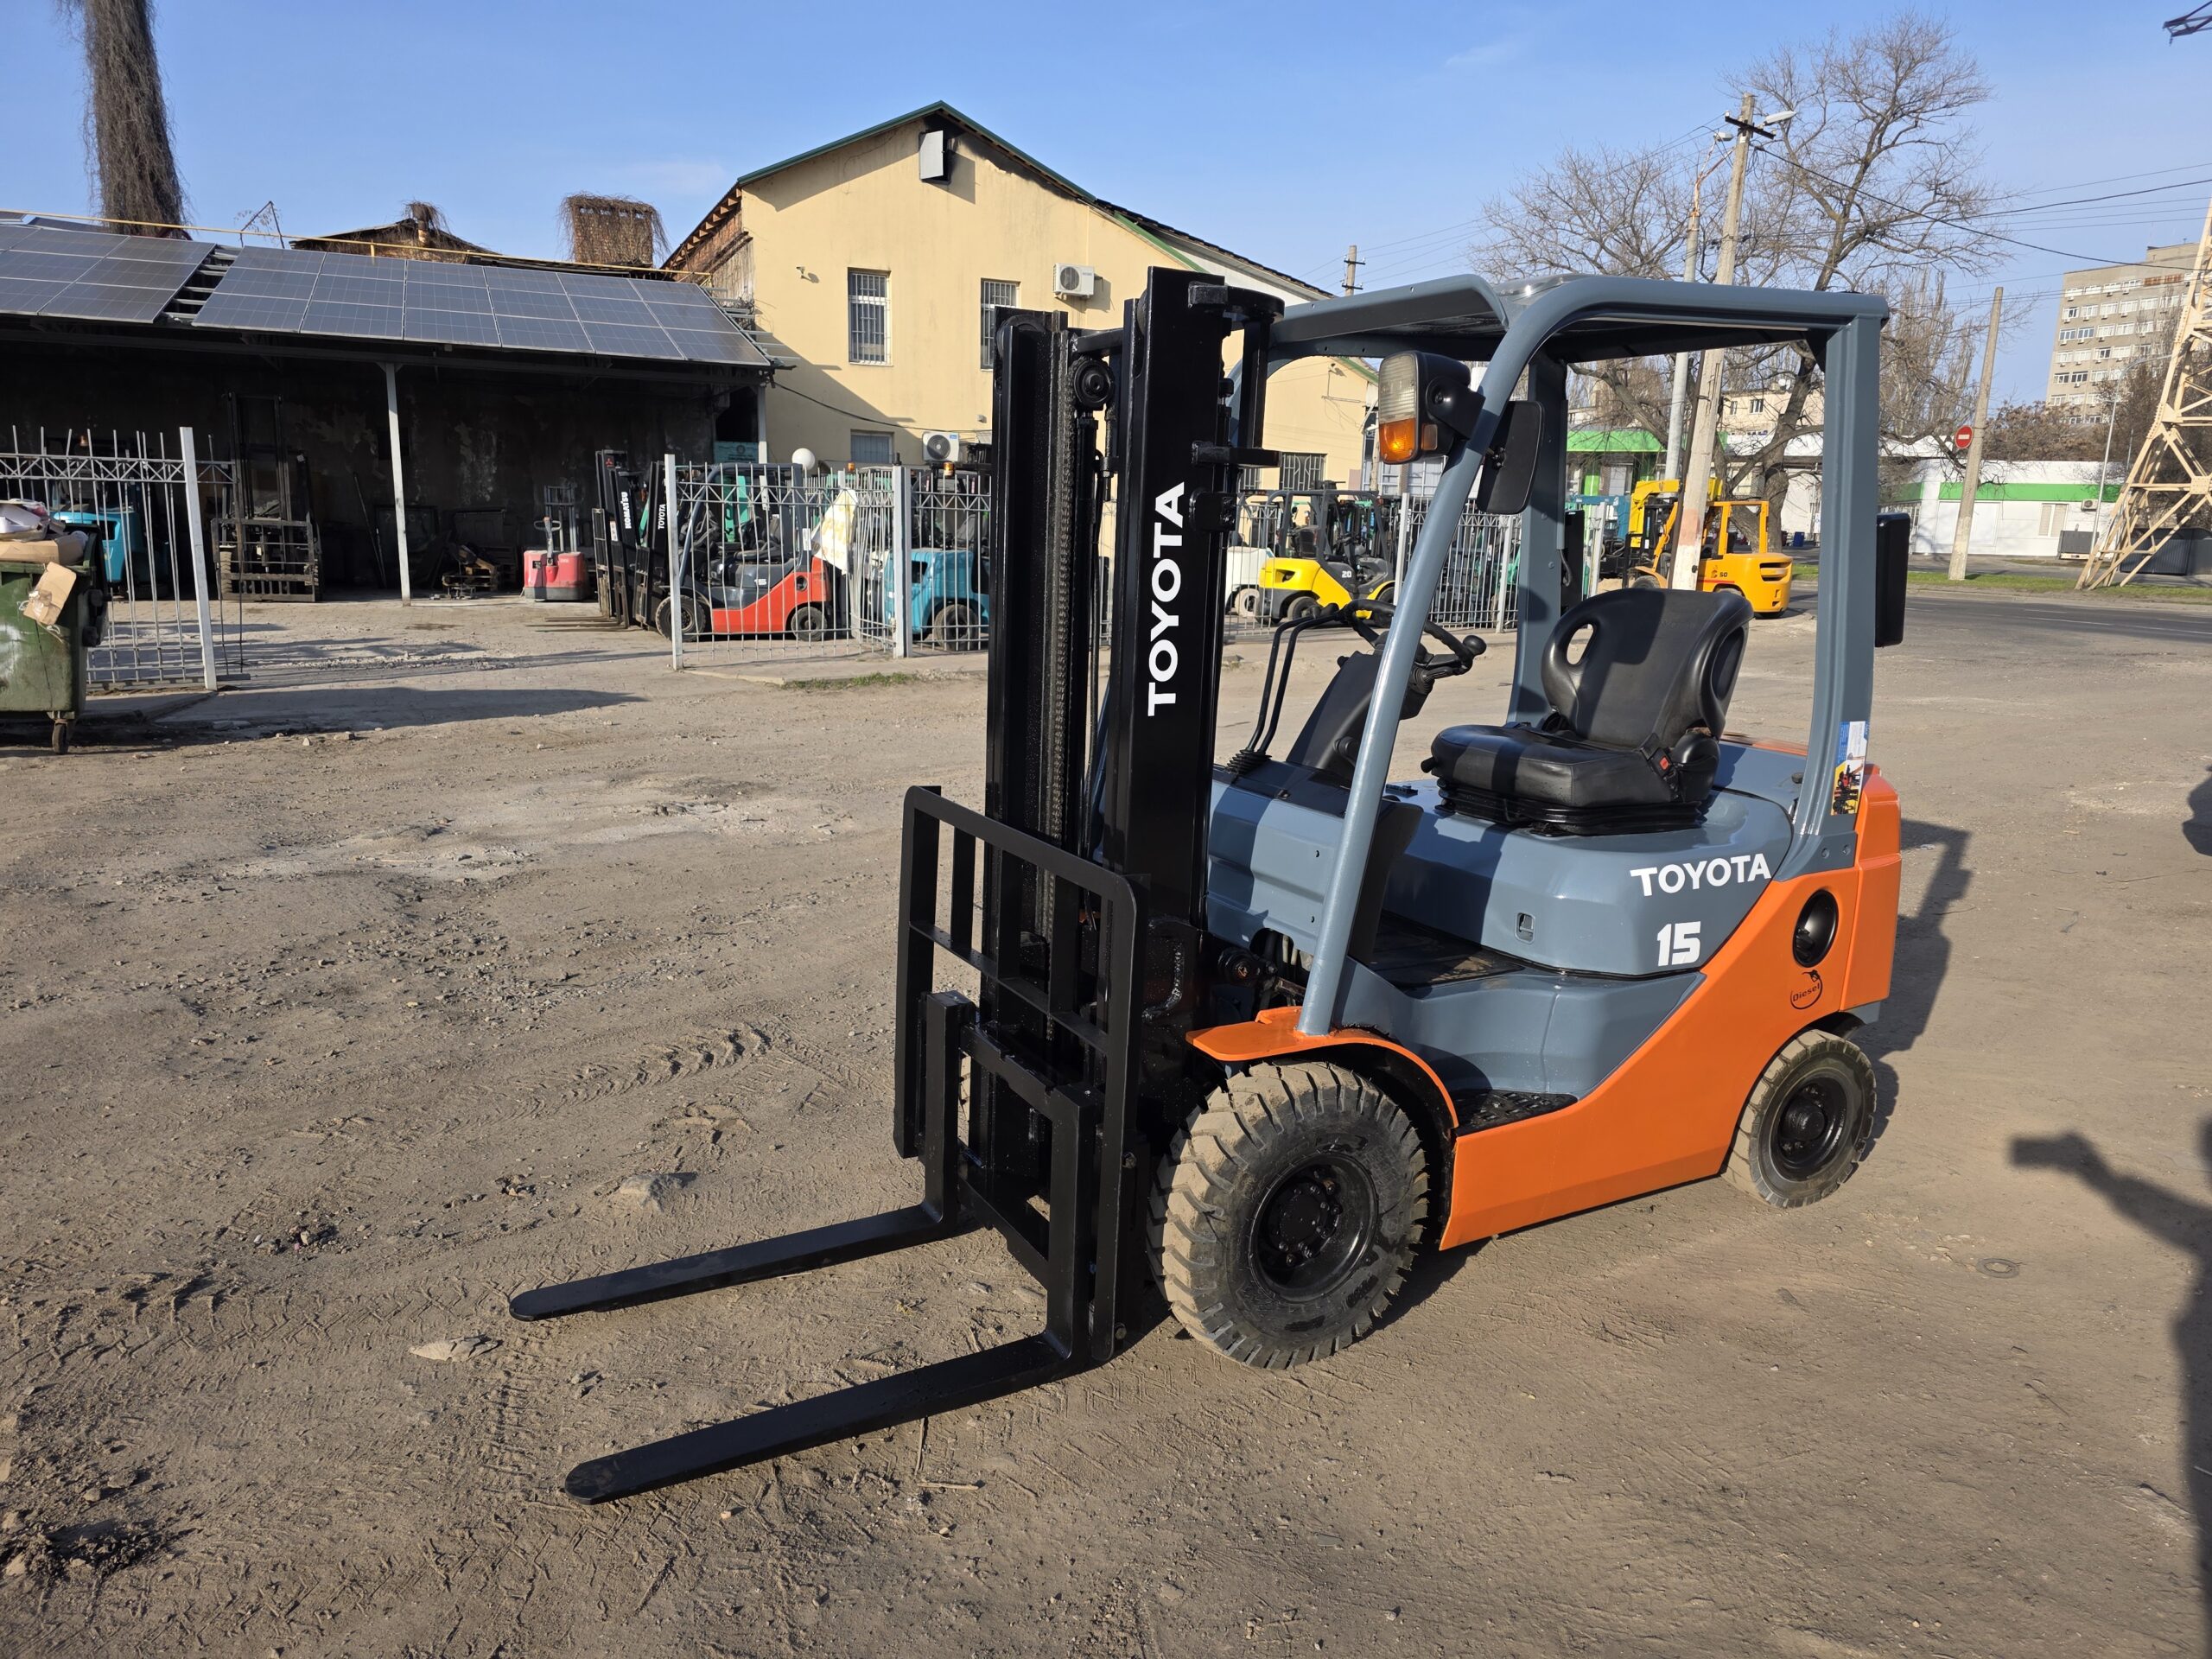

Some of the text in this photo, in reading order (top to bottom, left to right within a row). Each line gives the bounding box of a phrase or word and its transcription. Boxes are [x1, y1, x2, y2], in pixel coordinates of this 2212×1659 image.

[620, 491, 632, 530] KOMATSU
[658, 504, 666, 530] TOYOTA
[1147, 481, 1185, 717] TOYOTA
[1630, 853, 1772, 897] TOYOTA
[1656, 921, 1701, 967] 15
[1792, 982, 1821, 1002] Diesel
